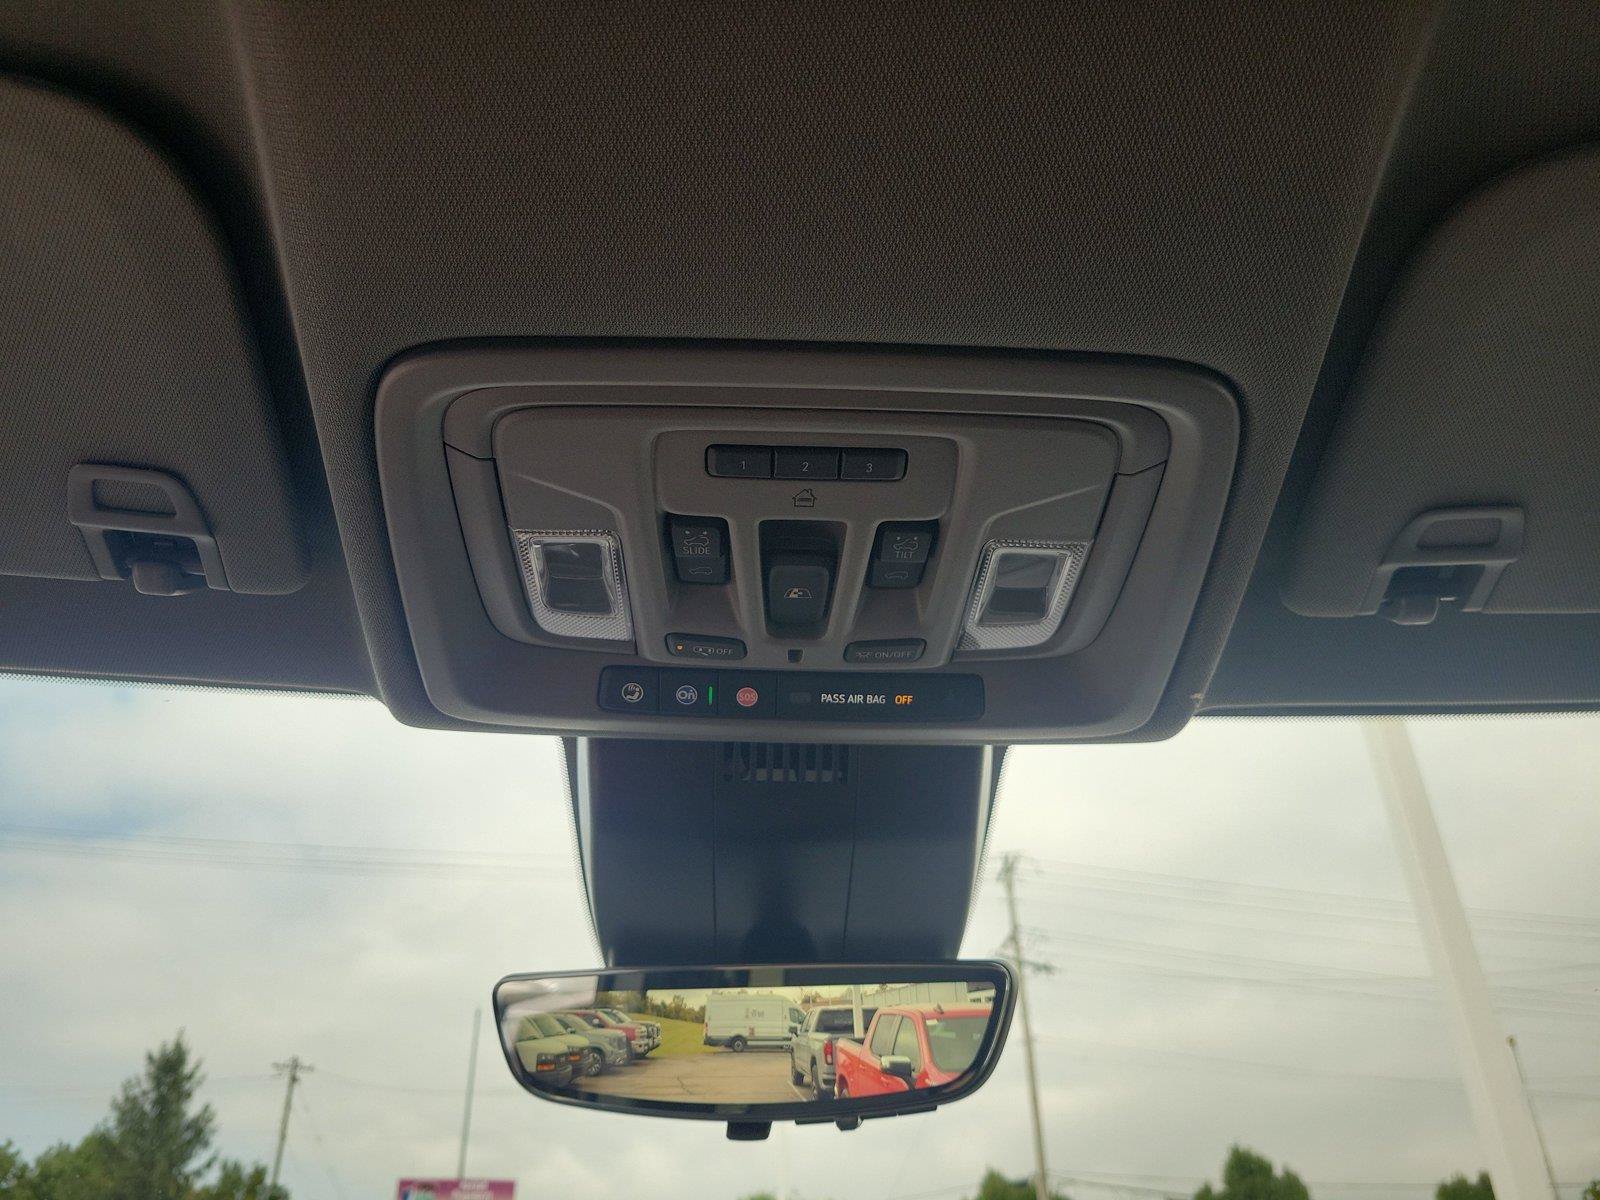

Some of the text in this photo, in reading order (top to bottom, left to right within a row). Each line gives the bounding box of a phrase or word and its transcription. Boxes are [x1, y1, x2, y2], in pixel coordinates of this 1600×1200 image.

[740, 460, 747, 470] 1
[802, 462, 809, 472] 2
[866, 463, 873, 472] 3
[683, 546, 711, 555] SLIDE
[895, 550, 914, 559] TILT
[716, 648, 734, 656] OFF
[738, 692, 757, 702] SOS
[821, 693, 913, 705] PASS AIR BAG OFF
